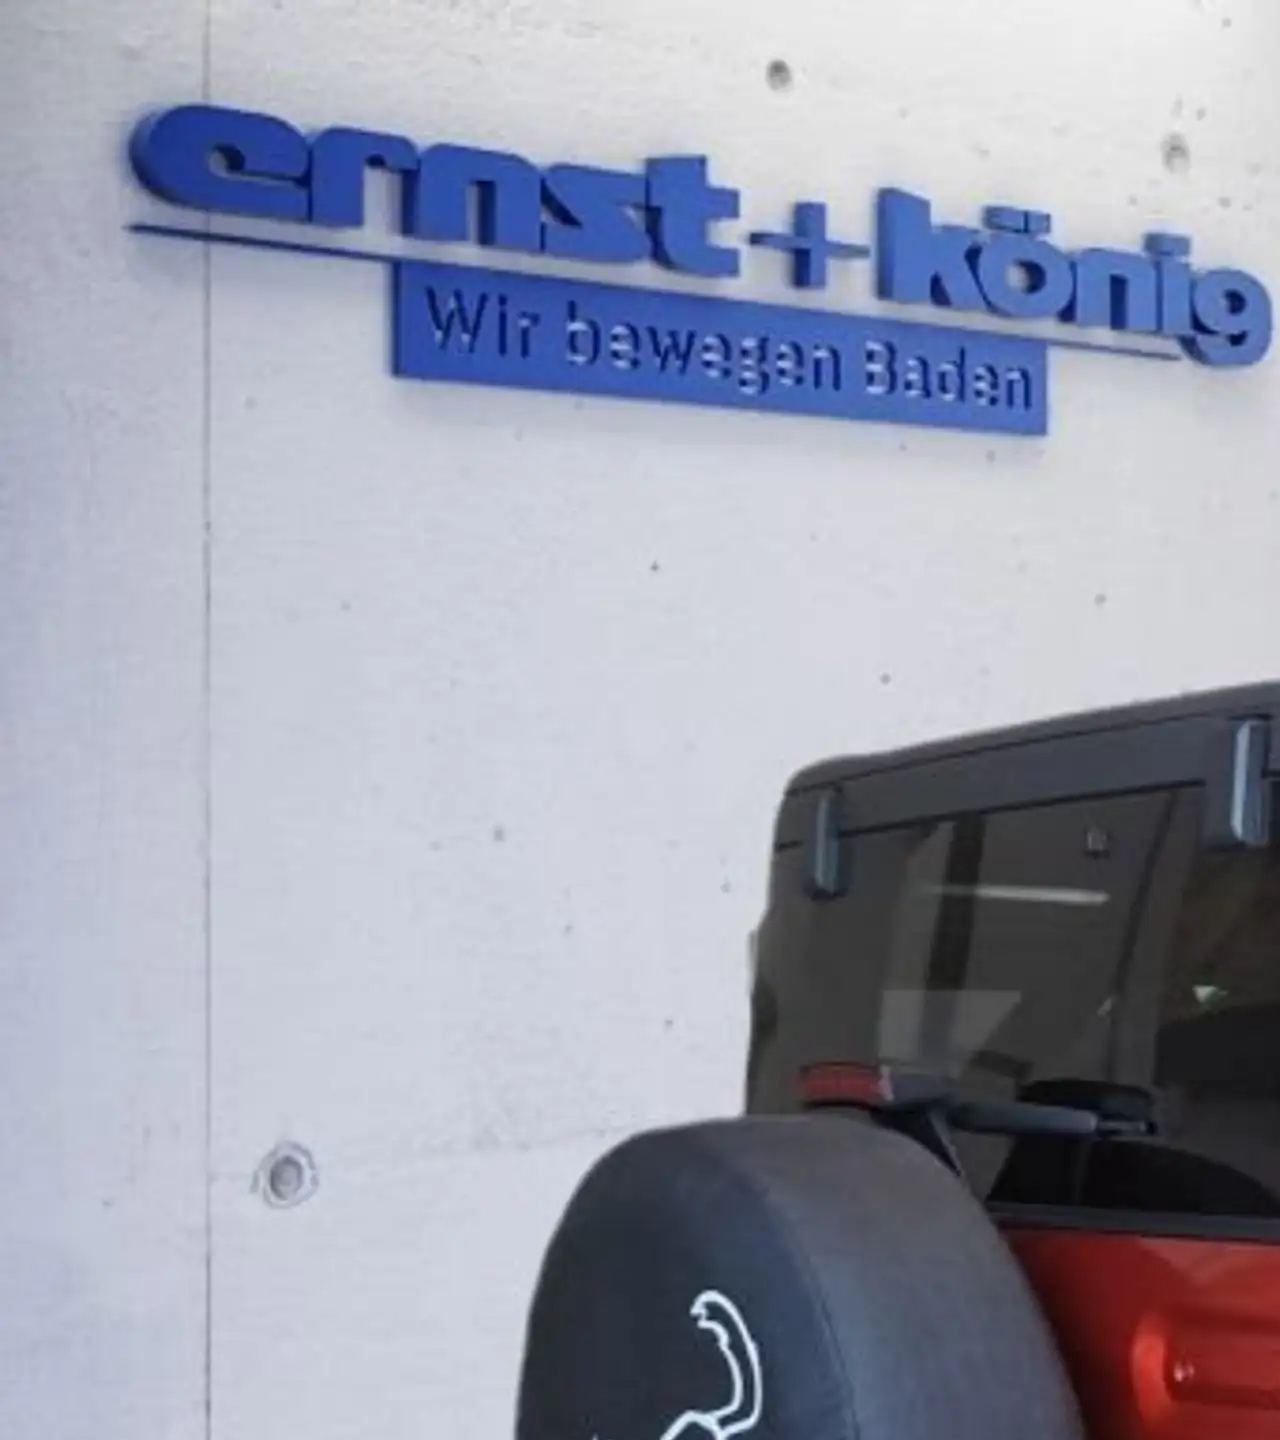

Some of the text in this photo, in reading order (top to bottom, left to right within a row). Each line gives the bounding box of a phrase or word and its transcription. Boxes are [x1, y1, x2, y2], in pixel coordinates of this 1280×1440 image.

[424, 285, 1033, 409] Wir bewegen Baden
